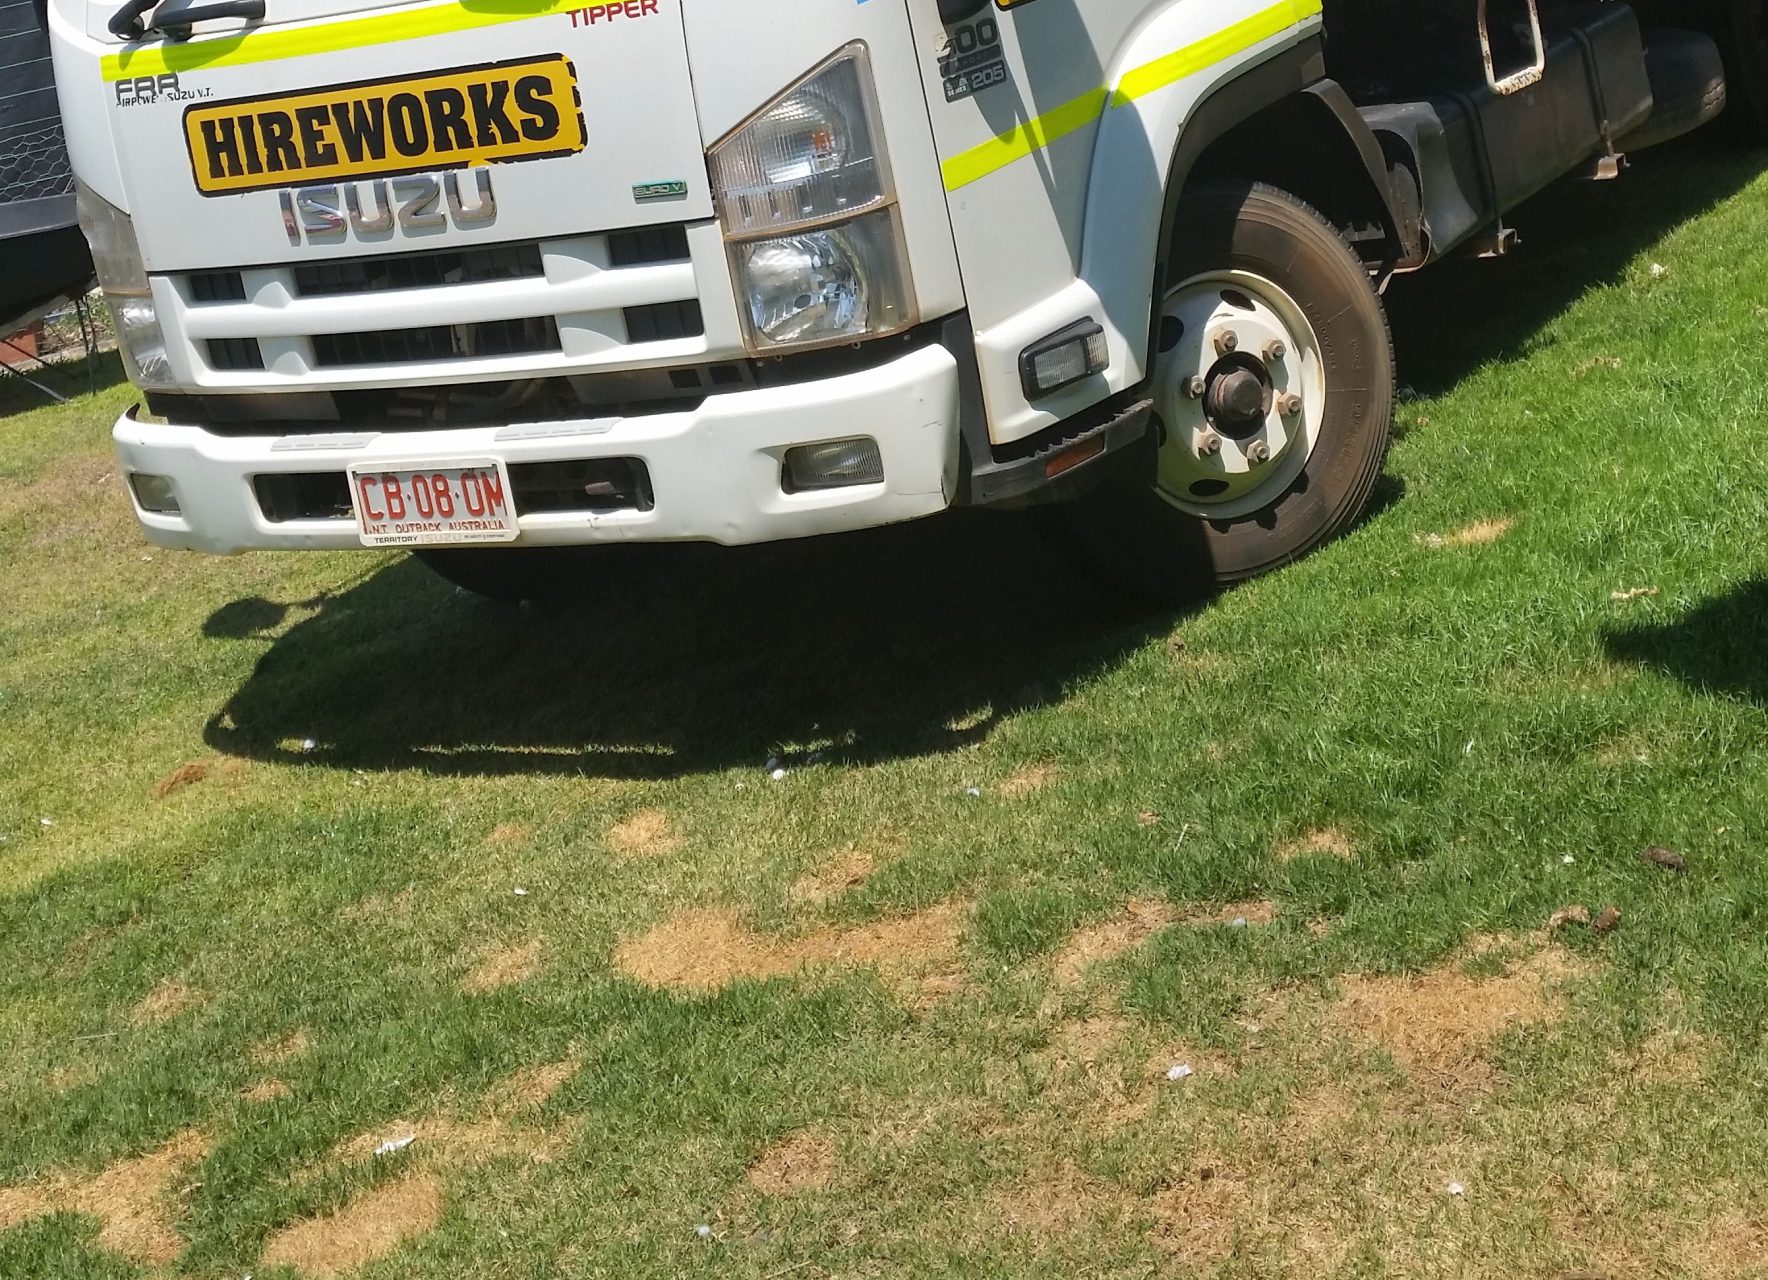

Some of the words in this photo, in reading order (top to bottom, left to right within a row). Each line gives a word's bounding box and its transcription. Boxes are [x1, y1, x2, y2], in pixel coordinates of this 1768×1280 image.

[115, 73, 181, 100] FRR
[971, 65, 1006, 89] 205
[116, 94, 160, 108] AIRPOWE
[163, 89, 195, 103] SUZU
[200, 75, 561, 179] HIREWORKS
[278, 166, 498, 239] ISUZU
[395, 521, 441, 534] OUTBACK
[449, 520, 505, 531] AUSTRALIA
[374, 535, 418, 544] TERRITORY
